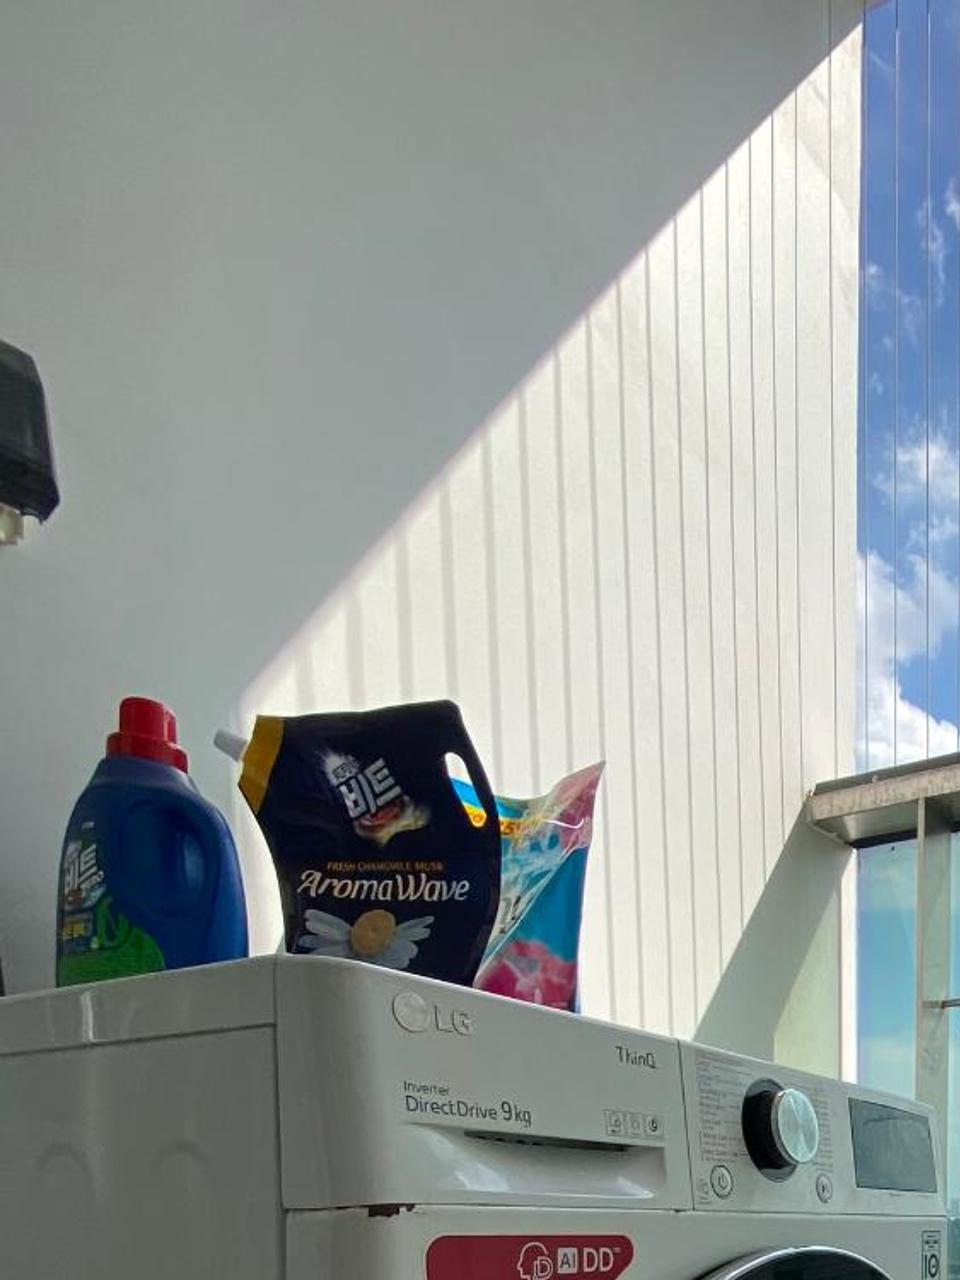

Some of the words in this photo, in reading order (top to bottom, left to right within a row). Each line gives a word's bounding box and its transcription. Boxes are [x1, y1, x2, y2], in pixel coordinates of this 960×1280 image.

[434, 1005, 473, 1036] LG
[614, 1046, 656, 1069] ThinQ
[403, 1080, 449, 1095] Inverter
[560, 1251, 576, 1270] AI
